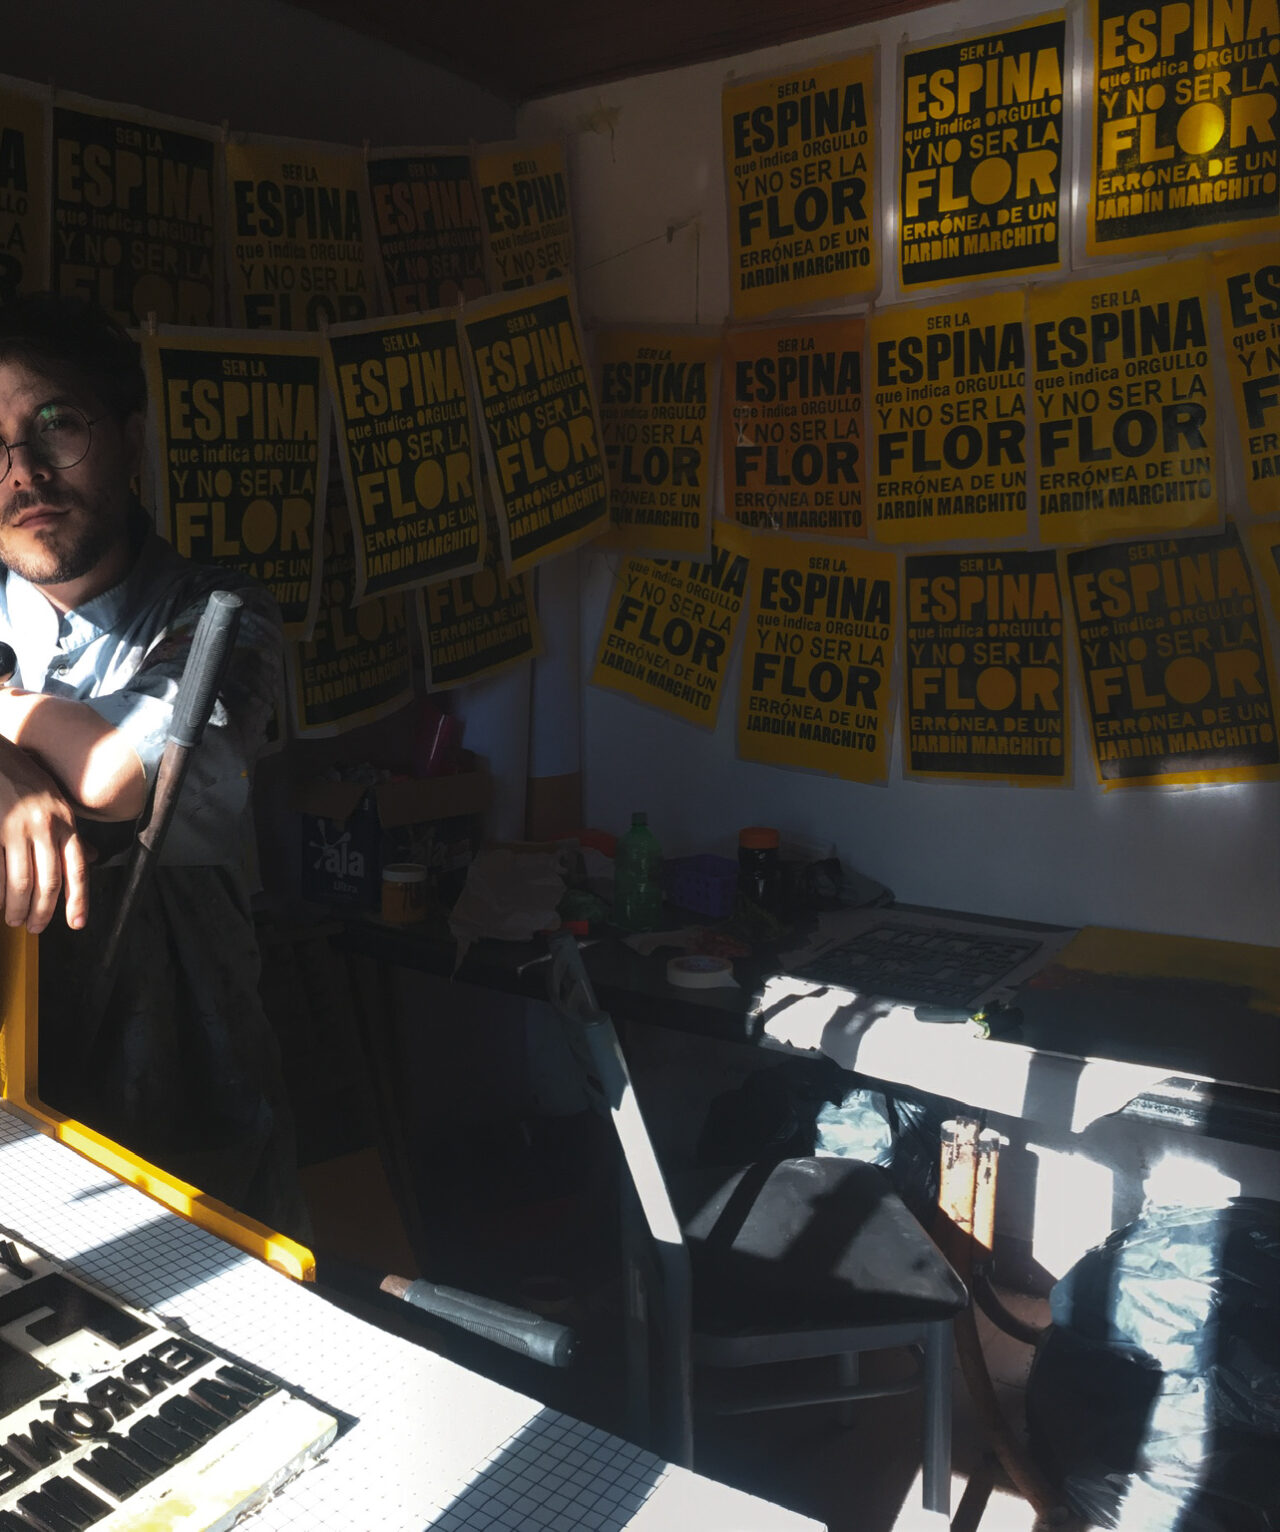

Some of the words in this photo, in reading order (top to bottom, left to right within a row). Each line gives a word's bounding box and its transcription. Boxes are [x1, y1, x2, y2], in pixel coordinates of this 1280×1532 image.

[960, 44, 984, 62] SER
[988, 40, 1004, 55] LA
[1100, 72, 1131, 92] que
[1135, 60, 1188, 82] indica
[1193, 37, 1280, 71] ORGULLO
[907, 47, 1060, 124] ESPINA
[733, 81, 866, 159] ESPINA
[904, 127, 931, 145] que
[936, 117, 980, 136] indica
[986, 98, 1061, 127] ORGULLO
[906, 146, 921, 169] Y
[928, 138, 962, 166] NO
[969, 127, 1018, 158] SER
[1027, 120, 1058, 150] LA
[1102, 91, 1276, 171] FLOR
[905, 148, 1055, 218] FLOR
[1098, 164, 1200, 195] ERRÓNEA
[1209, 156, 1238, 177] DE
[1245, 149, 1277, 170] UN
[235, 178, 365, 242] ESPINA
[738, 176, 866, 247] FLOR
[903, 213, 989, 241] ERRÓNEA
[997, 206, 1022, 225] DE
[1029, 201, 1056, 220] UN
[740, 261, 790, 291] JARDÍN
[792, 246, 869, 279] MARCHITO
[902, 235, 959, 265] JARDÍN
[963, 222, 1054, 255] MARCHITO
[1091, 292, 1119, 310] SER
[1122, 289, 1140, 305] LA
[475, 322, 581, 399] ESPINA
[877, 322, 1027, 387] ESPINA
[1035, 297, 1207, 372] ESPINA
[340, 349, 468, 418] ESPINA
[736, 351, 861, 402] ESPINA
[1037, 395, 1054, 418] Y
[1063, 389, 1100, 416] NO
[1108, 379, 1163, 410] SER
[1172, 373, 1206, 402] LA
[166, 376, 319, 440] ESPINA
[351, 445, 365, 472] Y
[372, 438, 402, 468] NO
[408, 428, 445, 460] SER
[448, 423, 469, 452] LA
[497, 414, 597, 496] FLOR
[737, 441, 859, 488] FLOR
[879, 419, 1025, 477] FLOR
[358, 451, 474, 528] FLOR
[1040, 486, 1104, 515] JARDÍN
[1109, 478, 1209, 508] MARCHITO
[174, 497, 312, 561] FLOR
[760, 567, 891, 624] ESPINA
[910, 572, 1060, 622] ESPINA
[1073, 548, 1250, 622] ESPINA
[614, 593, 725, 673] FLOR
[757, 614, 780, 627] que
[784, 614, 822, 632] indica
[825, 620, 890, 641] ORGULLO
[910, 643, 925, 665] Y
[933, 643, 965, 665] NO
[973, 642, 1021, 665] SER
[1029, 642, 1060, 665] LA
[752, 652, 881, 710] FLOR
[912, 666, 1058, 711] FLOR
[1089, 648, 1262, 715] FLOR
[748, 696, 823, 722] ERRÓNEA
[829, 709, 851, 726] DE
[855, 714, 878, 731] UN
